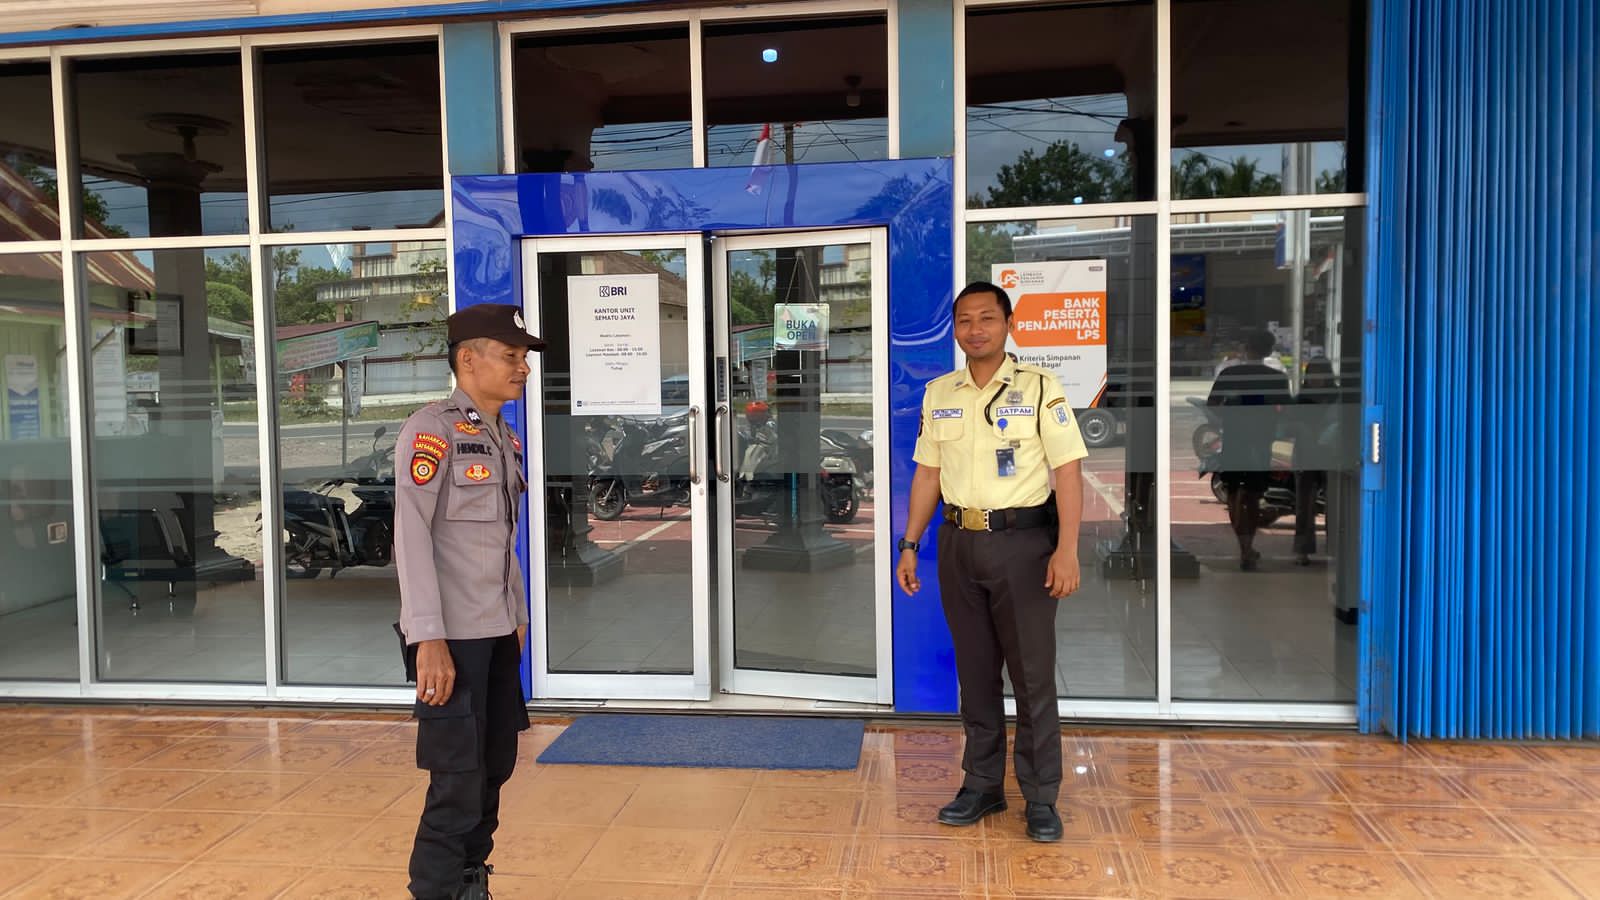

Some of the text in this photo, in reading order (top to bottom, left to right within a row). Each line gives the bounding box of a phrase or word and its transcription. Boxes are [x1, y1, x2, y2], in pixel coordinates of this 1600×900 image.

[611, 286, 627, 296] BRI
[1063, 297, 1100, 309] BANK
[1043, 308, 1100, 320] PESERTA
[786, 319, 817, 329] BUKA
[1017, 319, 1100, 331] PENJAMINAN
[787, 330, 816, 341] OPEN
[1076, 329, 1100, 340] LPS
[1019, 353, 1081, 362] Kriteria Simpanan
[1041, 361, 1062, 369] Bayar
[999, 407, 1032, 415] SATPAM
